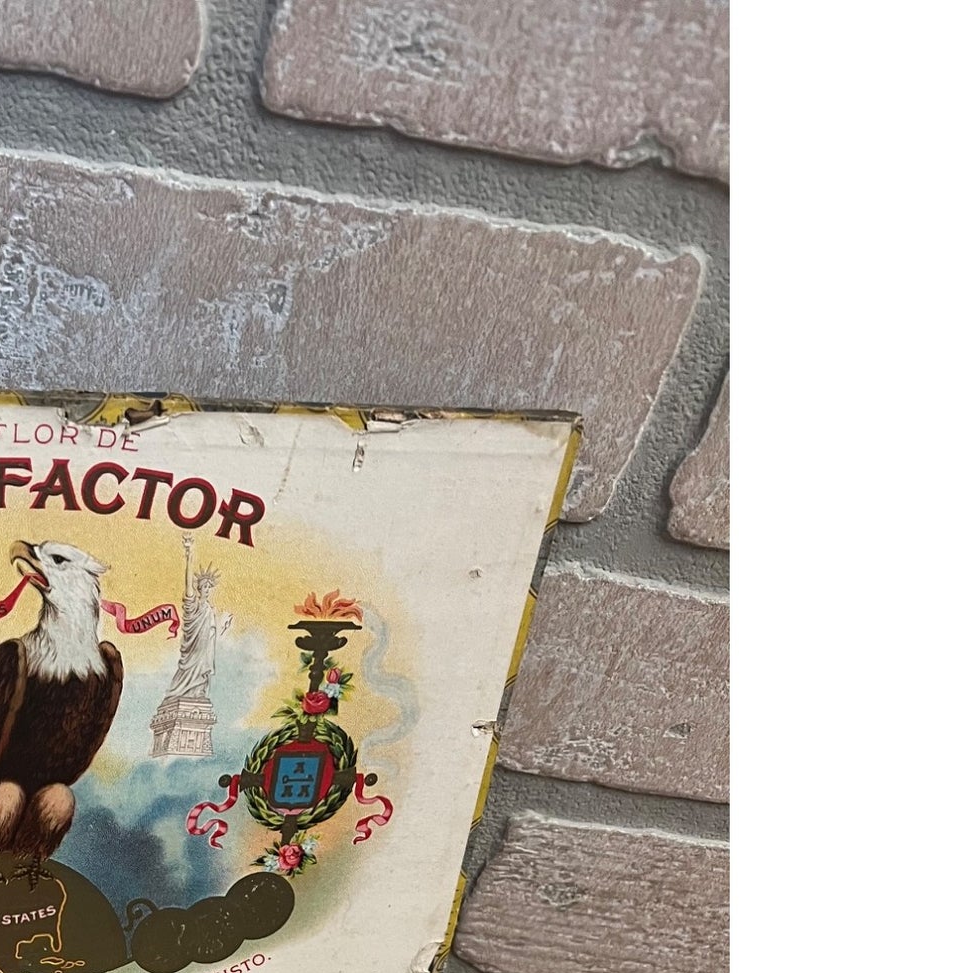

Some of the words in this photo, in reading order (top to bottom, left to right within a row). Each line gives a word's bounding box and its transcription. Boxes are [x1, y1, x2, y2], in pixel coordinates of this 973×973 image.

[96, 428, 141, 452] DE
[132, 608, 172, 633] UNUM
[1, 904, 57, 925] STATES
